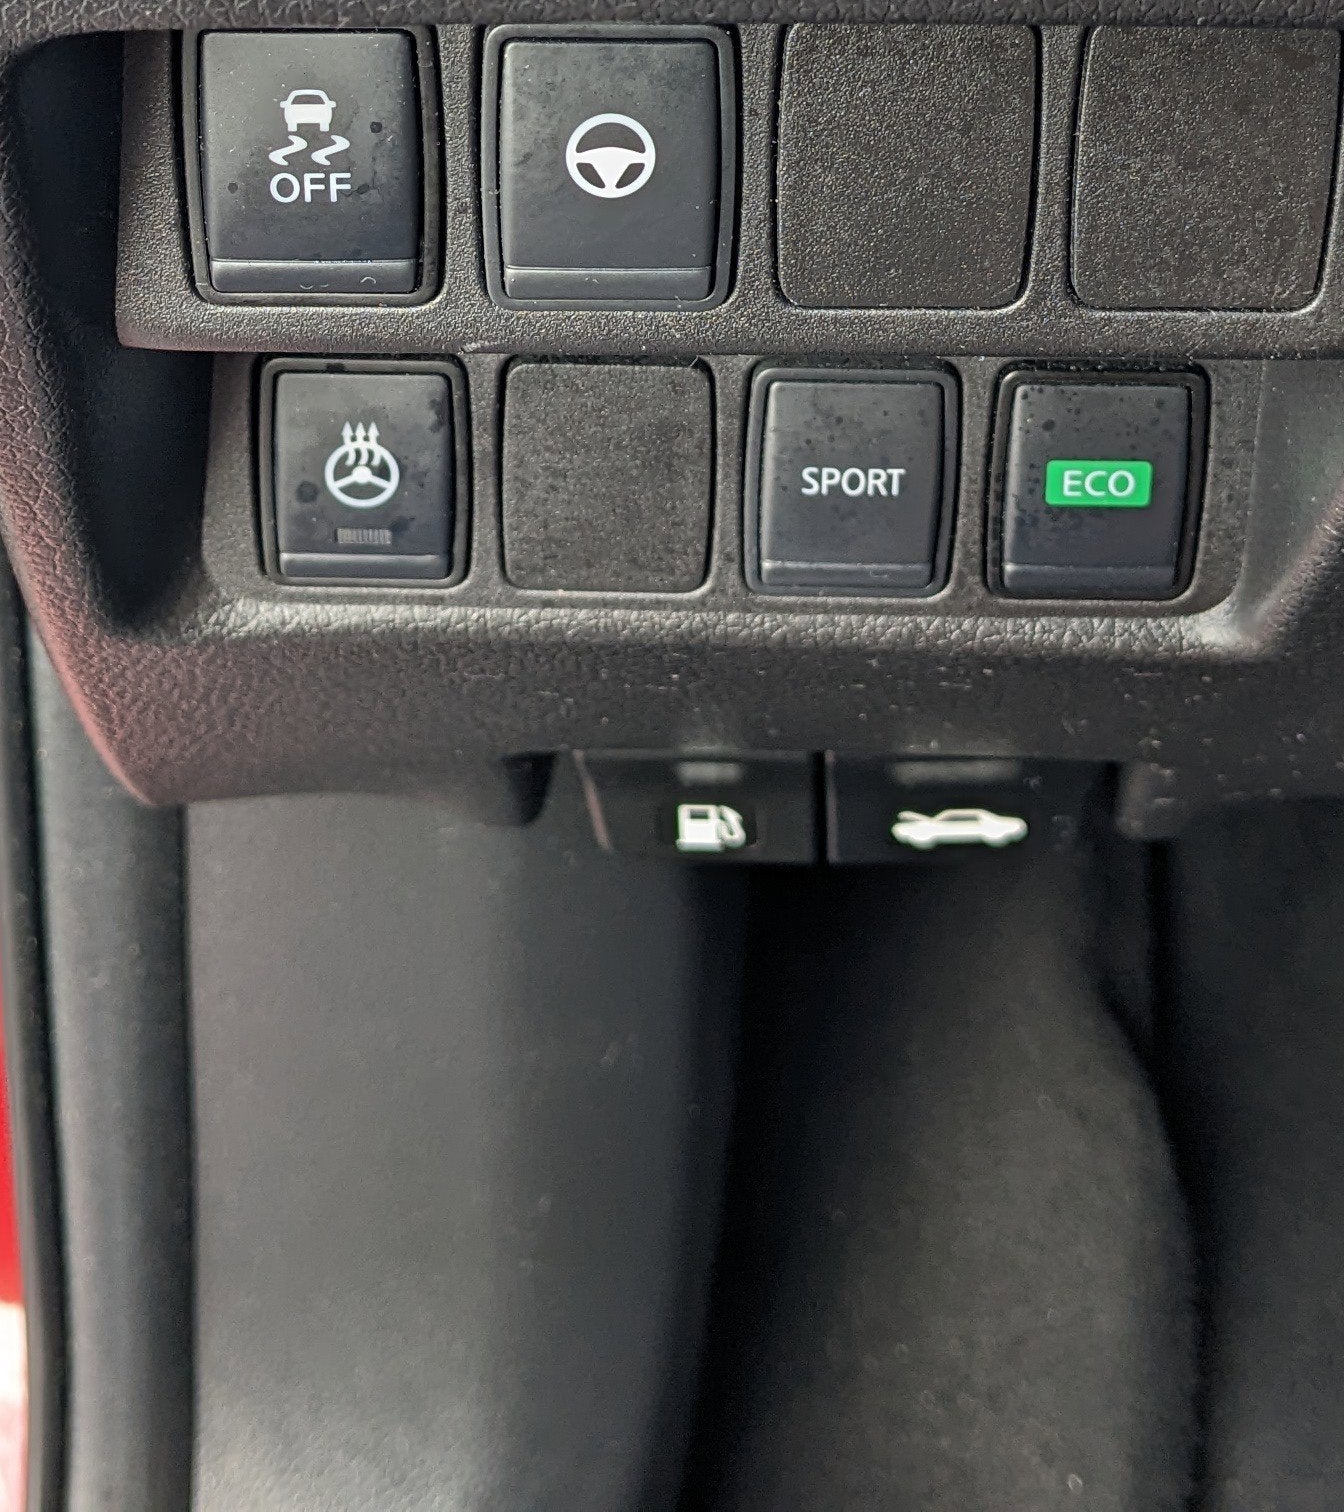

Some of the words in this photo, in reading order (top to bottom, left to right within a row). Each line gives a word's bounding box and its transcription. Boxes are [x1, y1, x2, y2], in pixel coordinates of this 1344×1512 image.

[269, 172, 352, 203] OFF
[800, 466, 906, 498] SPORT
[1062, 469, 1136, 498] ECO
